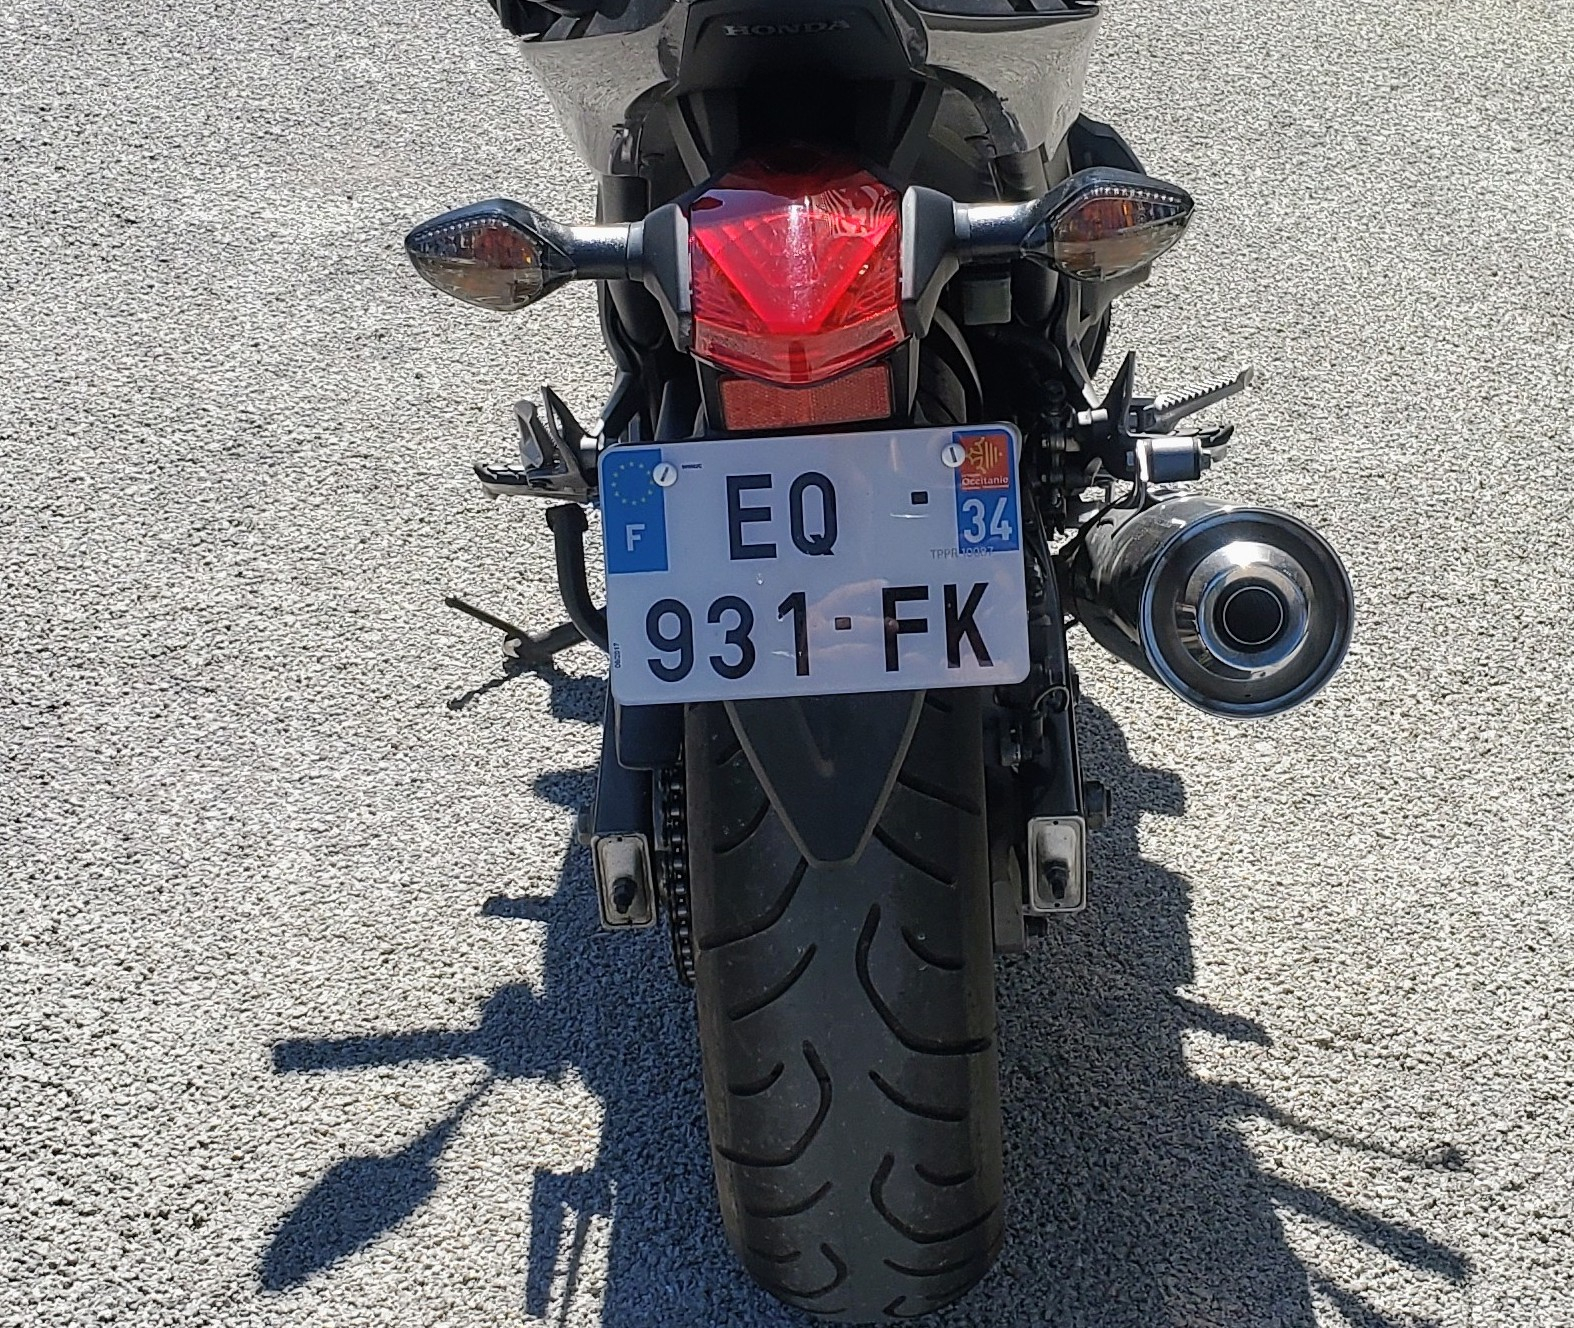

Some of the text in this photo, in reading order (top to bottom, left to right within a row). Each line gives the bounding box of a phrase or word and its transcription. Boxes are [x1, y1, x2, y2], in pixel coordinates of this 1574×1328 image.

[724, 19, 850, 36] HONDA
[962, 476, 1009, 487] Occitanie
[726, 471, 839, 560] EQ
[962, 497, 1012, 543] 34
[626, 524, 646, 552] F
